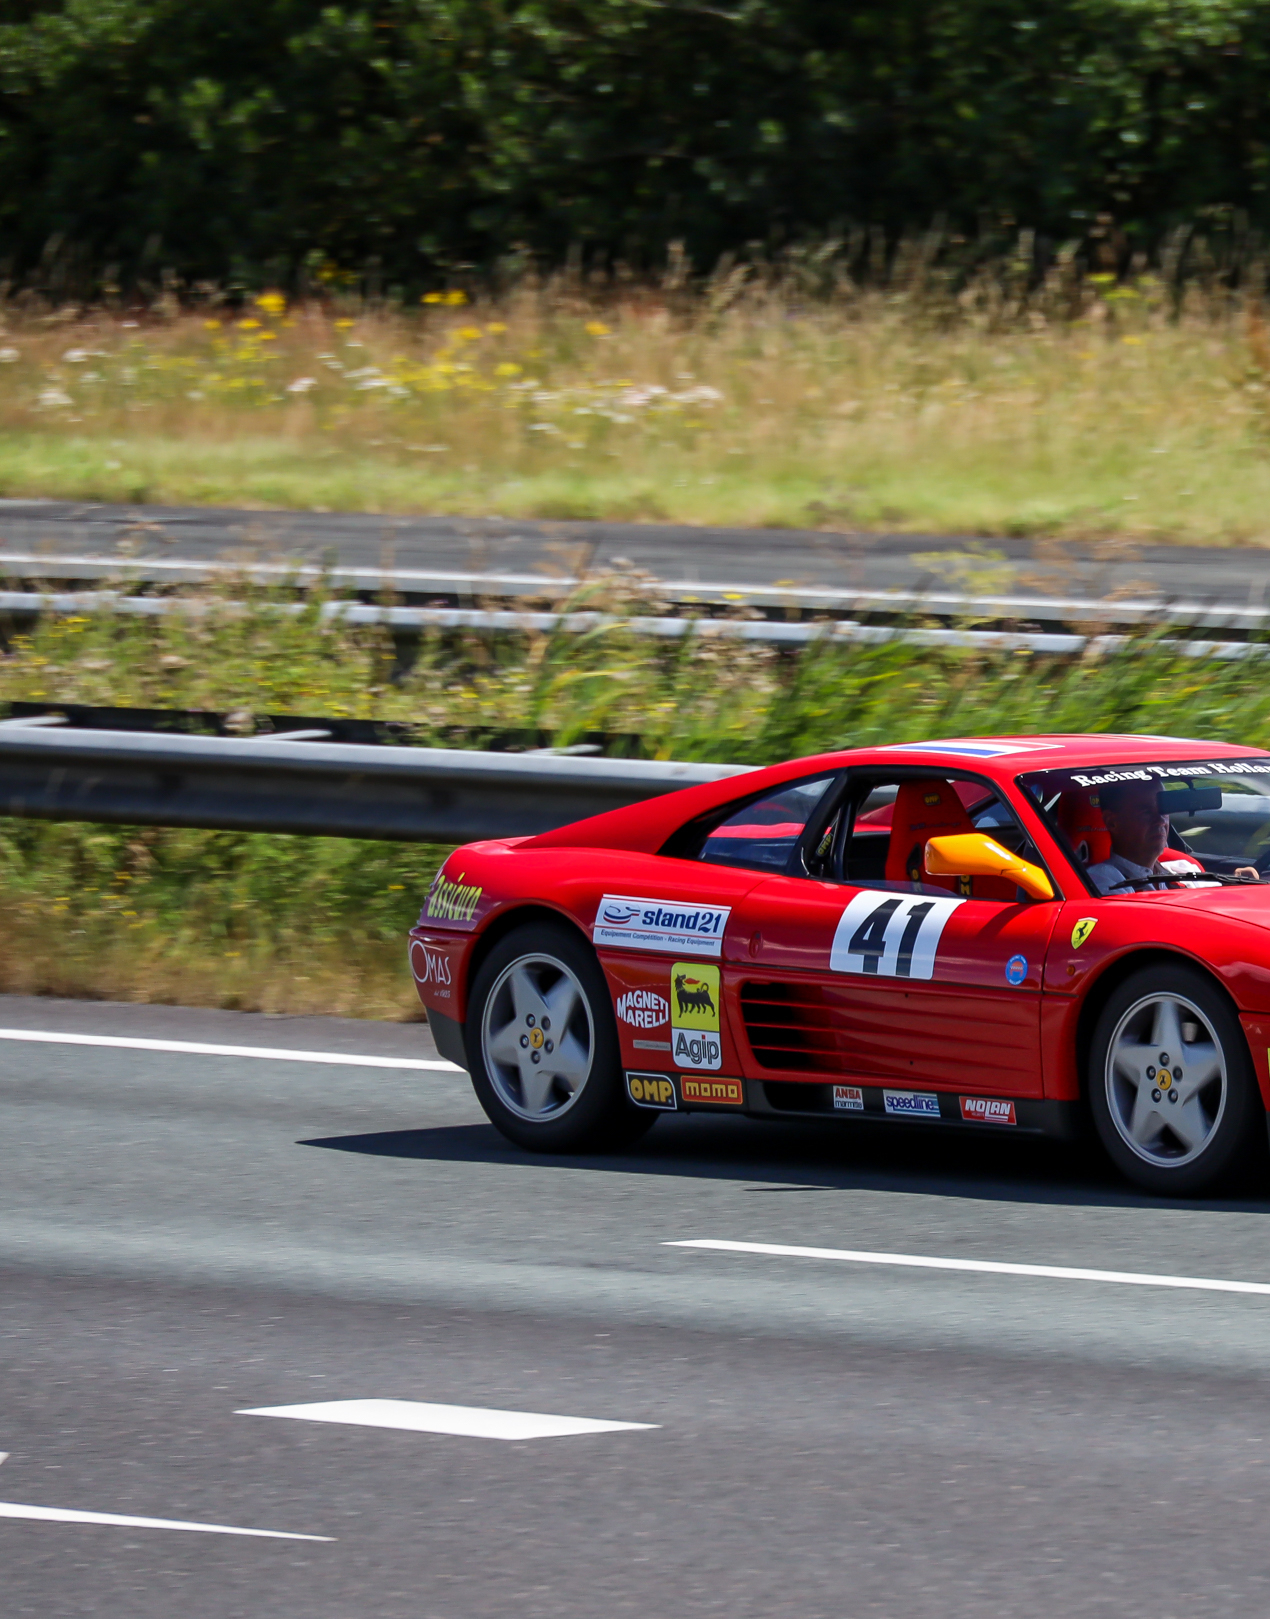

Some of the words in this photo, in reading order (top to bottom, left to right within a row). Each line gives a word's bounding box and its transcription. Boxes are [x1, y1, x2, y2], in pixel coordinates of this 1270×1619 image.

[1071, 768, 1152, 787] Racing
[1147, 762, 1212, 778] Team
[642, 908, 721, 934] stand21
[601, 929, 631, 938] Equipement
[668, 936, 685, 945] Racing
[686, 937, 715, 947] Equipment
[848, 898, 936, 977] 41
[410, 940, 452, 985] OMAS
[617, 990, 669, 1015] MAGNETI
[617, 1004, 669, 1029] MARELLI
[675, 1032, 720, 1064] Agip
[630, 1078, 672, 1103] OMP
[685, 1081, 738, 1098] momo
[835, 1087, 861, 1100] ANSA
[886, 1094, 935, 1111] speedline
[965, 1099, 1010, 1117] NOLAN
